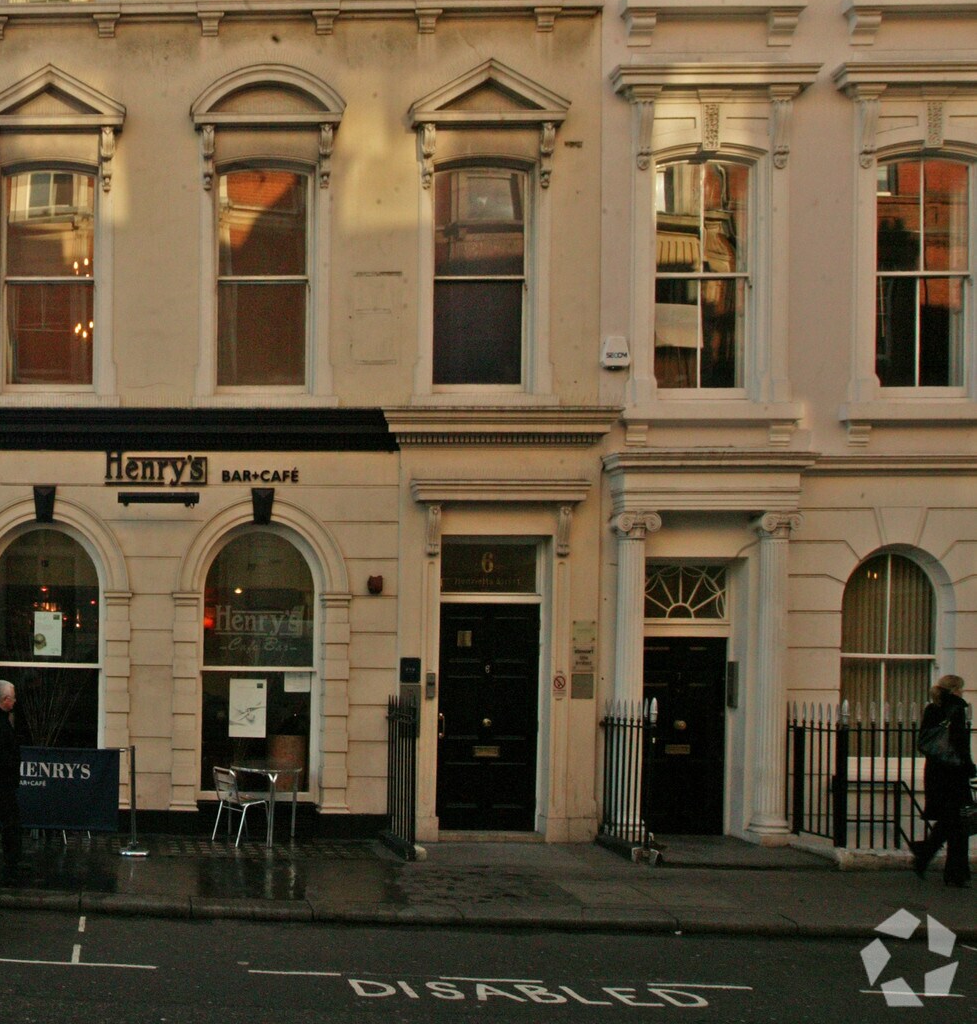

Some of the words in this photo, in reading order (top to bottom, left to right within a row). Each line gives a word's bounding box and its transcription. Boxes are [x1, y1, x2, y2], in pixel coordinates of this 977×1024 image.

[104, 450, 206, 486] Henry's
[221, 467, 299, 483] BAR+CAFÉ
[481, 552, 494, 573] 6
[214, 605, 303, 636] Henry's
[19, 779, 46, 787] AR+CAFÉ
[347, 979, 709, 1008] DISABLED
